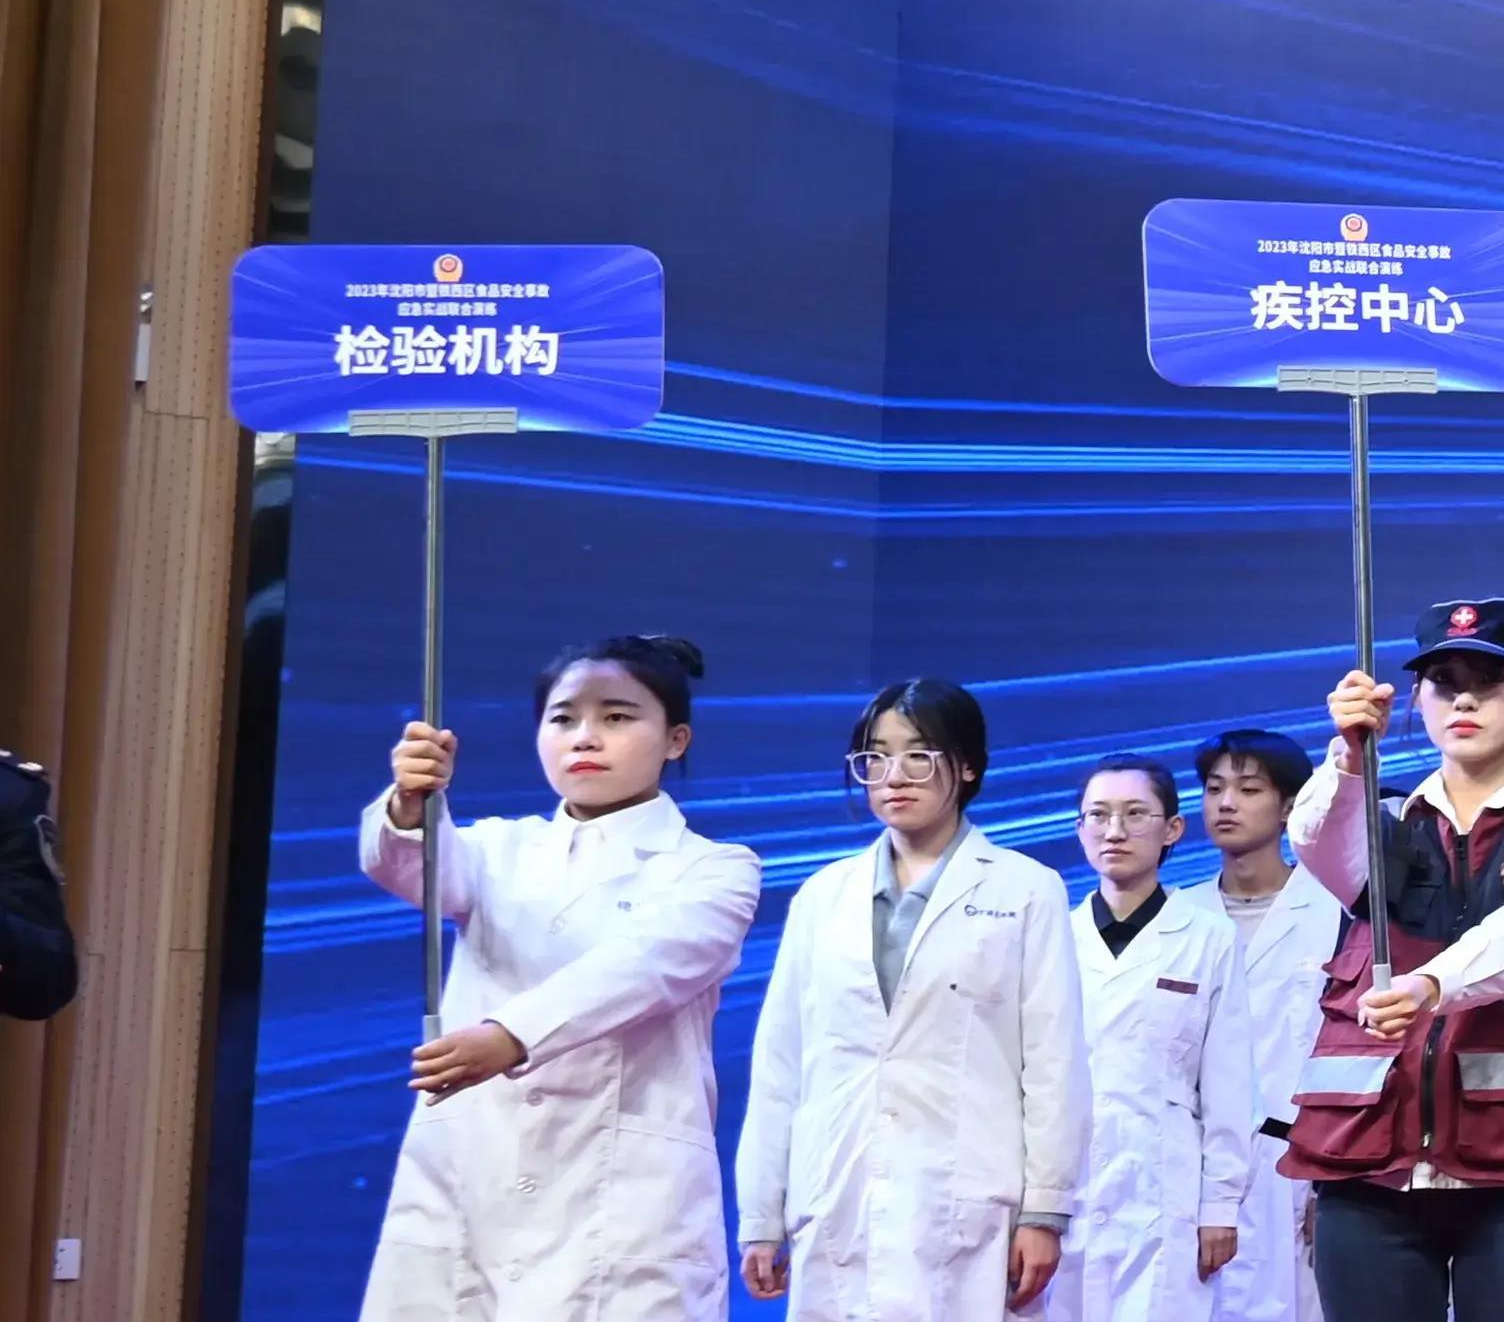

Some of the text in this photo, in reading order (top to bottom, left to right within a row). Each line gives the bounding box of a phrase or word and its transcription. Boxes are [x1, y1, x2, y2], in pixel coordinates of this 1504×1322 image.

[1249, 280, 1466, 334] 疾控中心
[333, 324, 560, 376] 检验机构
